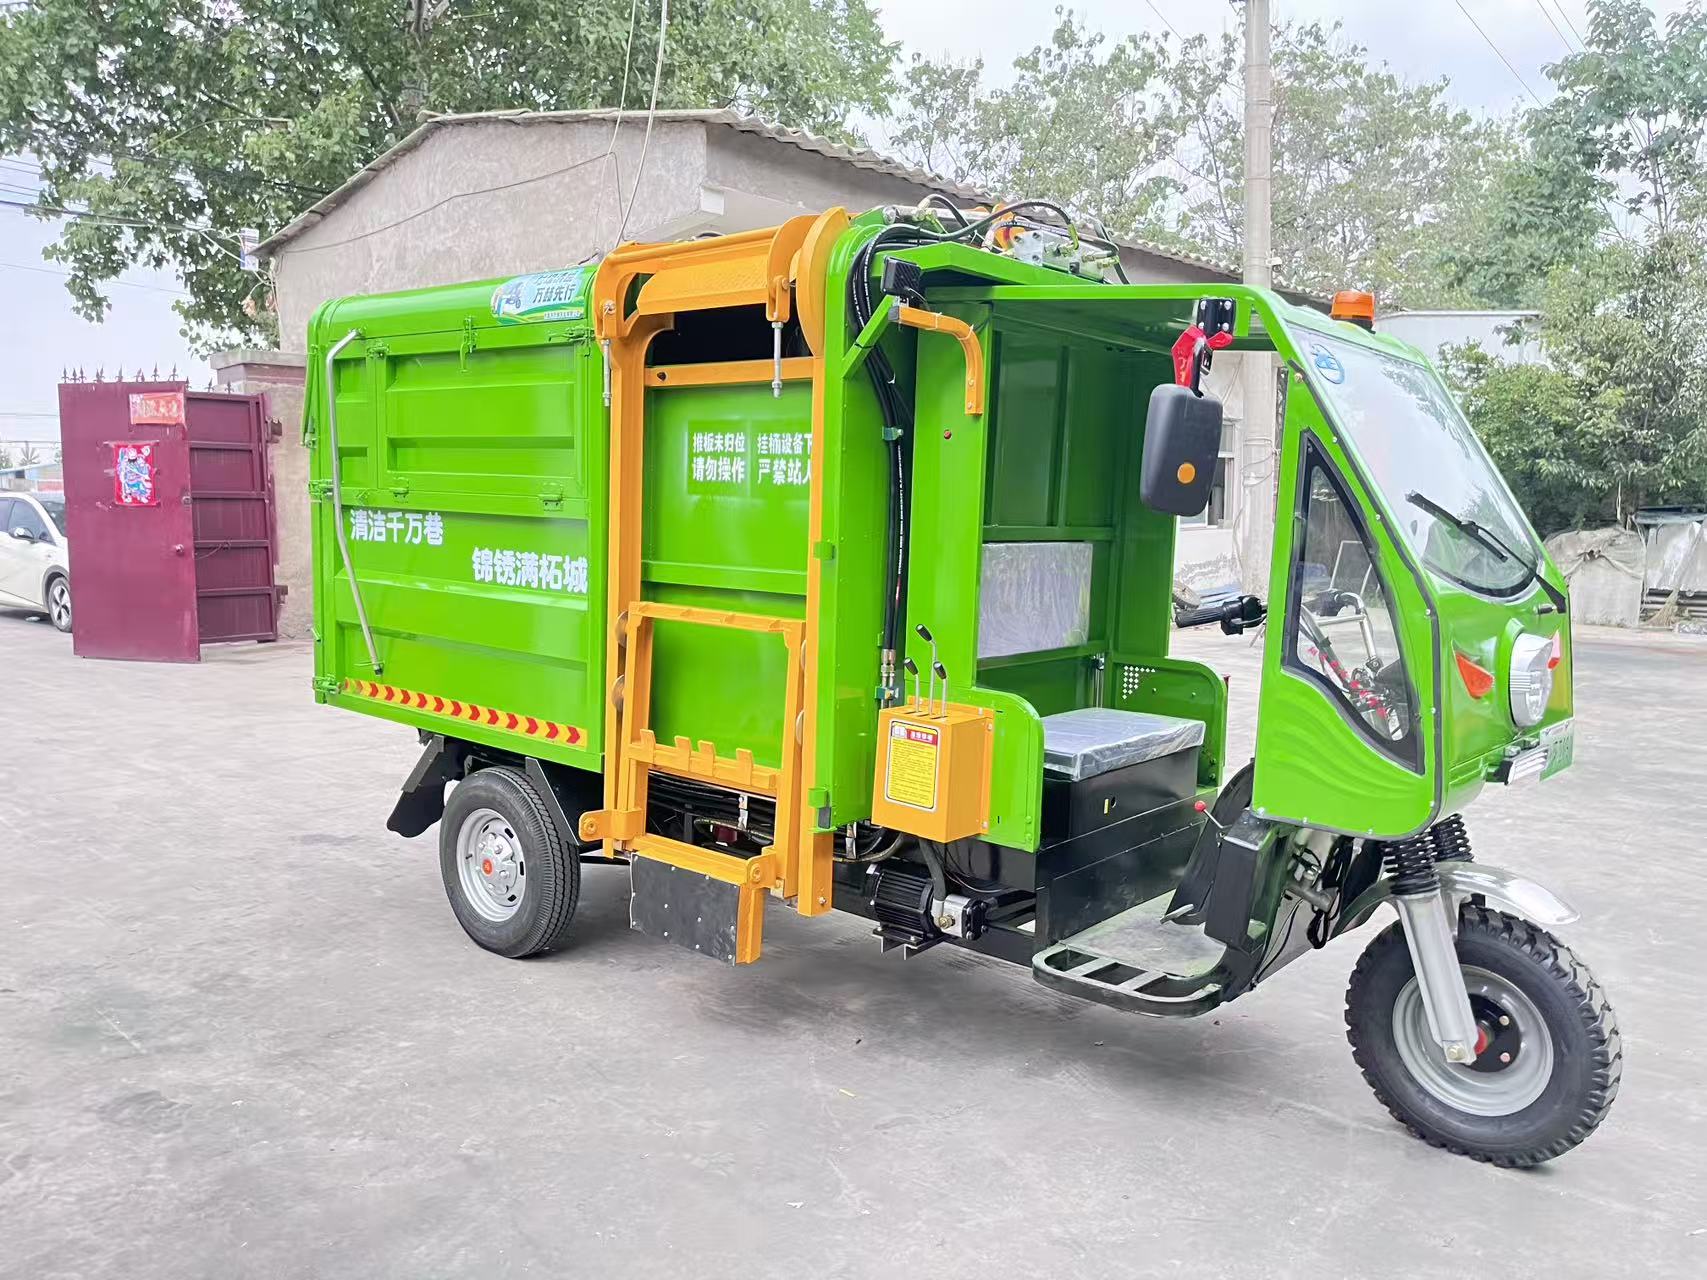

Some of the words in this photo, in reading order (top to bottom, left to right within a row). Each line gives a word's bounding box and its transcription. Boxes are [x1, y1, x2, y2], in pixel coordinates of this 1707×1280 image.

[692, 432, 745, 453] 推板未归位
[692, 456, 745, 483] 请勿操作
[350, 509, 444, 545] 清洁千万巷
[472, 547, 588, 594] 锦绣满柘城
